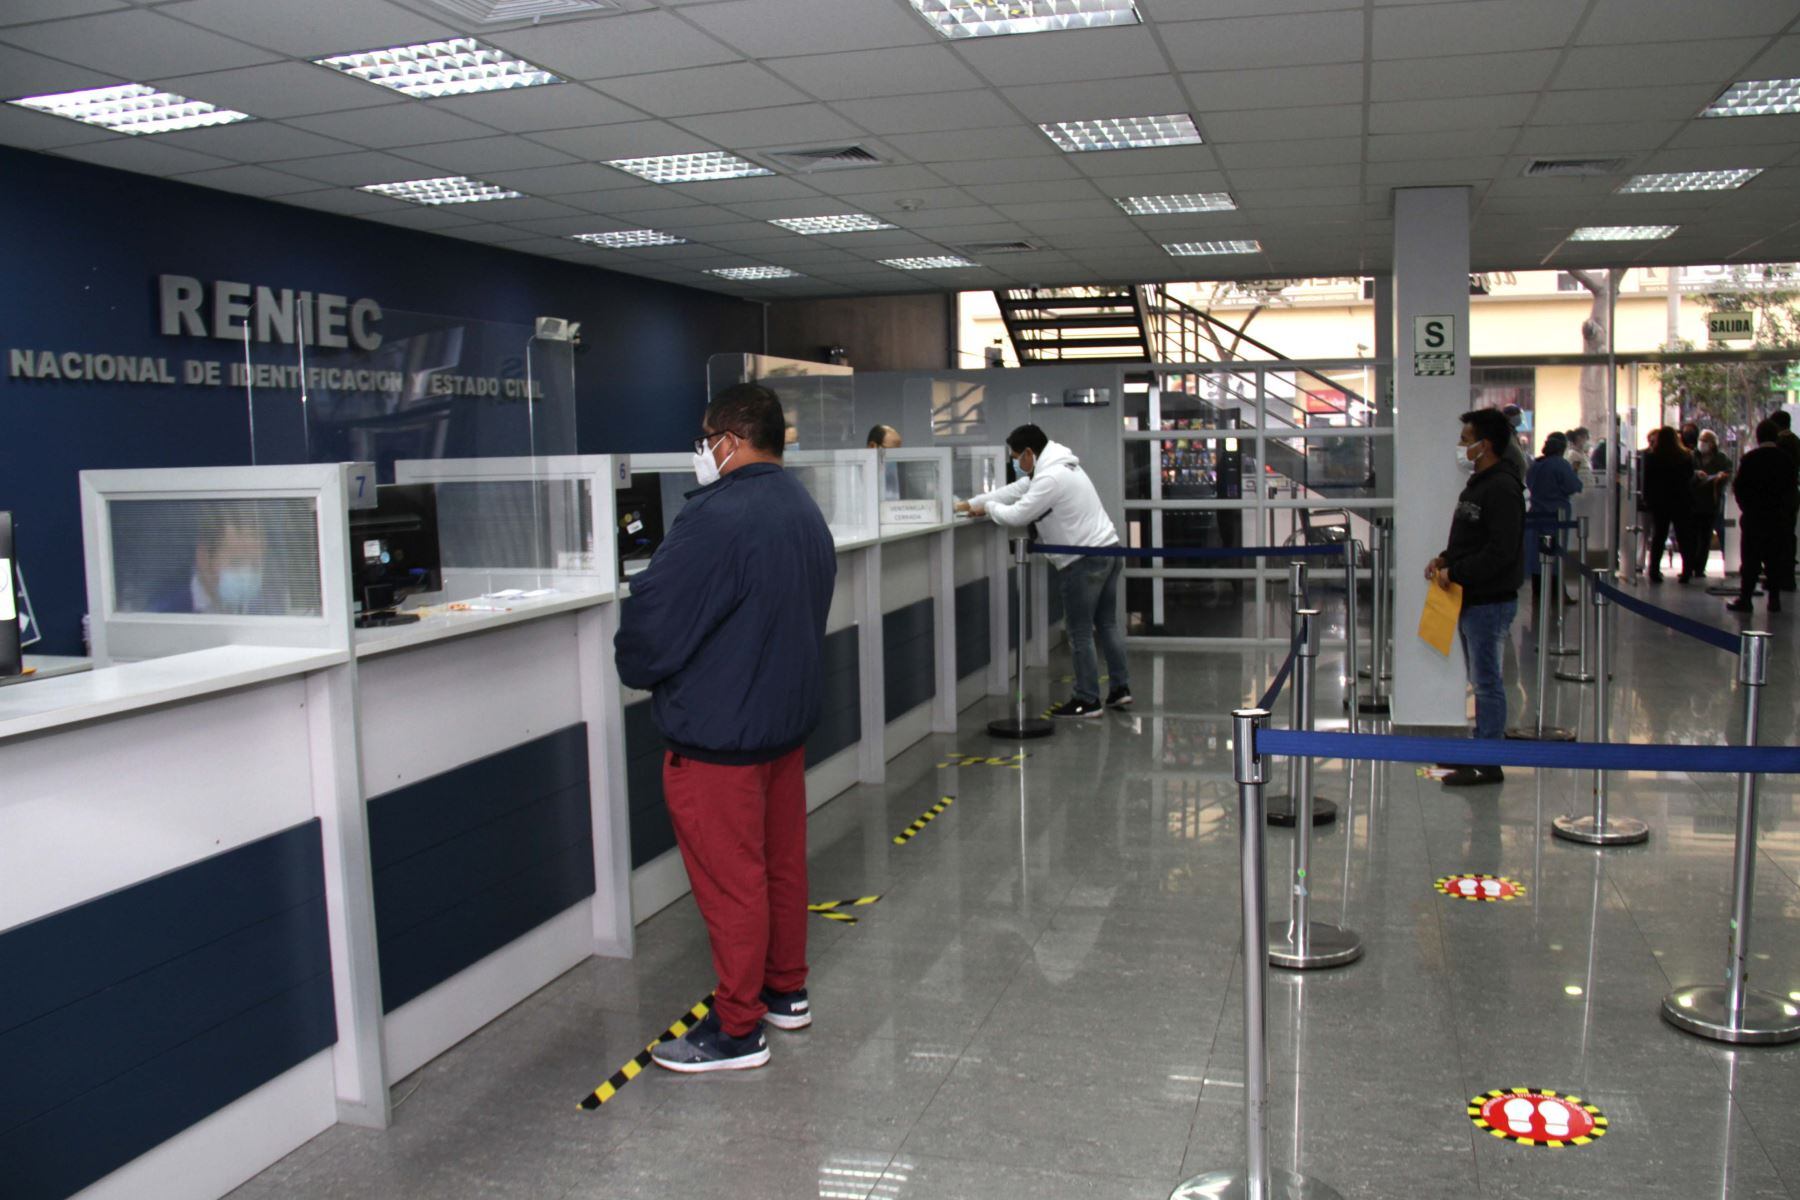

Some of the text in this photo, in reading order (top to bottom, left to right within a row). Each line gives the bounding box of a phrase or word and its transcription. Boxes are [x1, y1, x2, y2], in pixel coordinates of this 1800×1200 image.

[160, 274, 383, 350] RENIEC
[1424, 321, 1445, 348] S
[1711, 319, 1750, 333] SALIDA
[10, 349, 175, 384] NACIONAL
[185, 359, 221, 386] DE
[230, 363, 403, 392] IDENTFICACION
[431, 374, 499, 396] ESTADO
[505, 378, 545, 399] CIVIL
[619, 463, 626, 480] 6
[355, 476, 366, 497] 7
